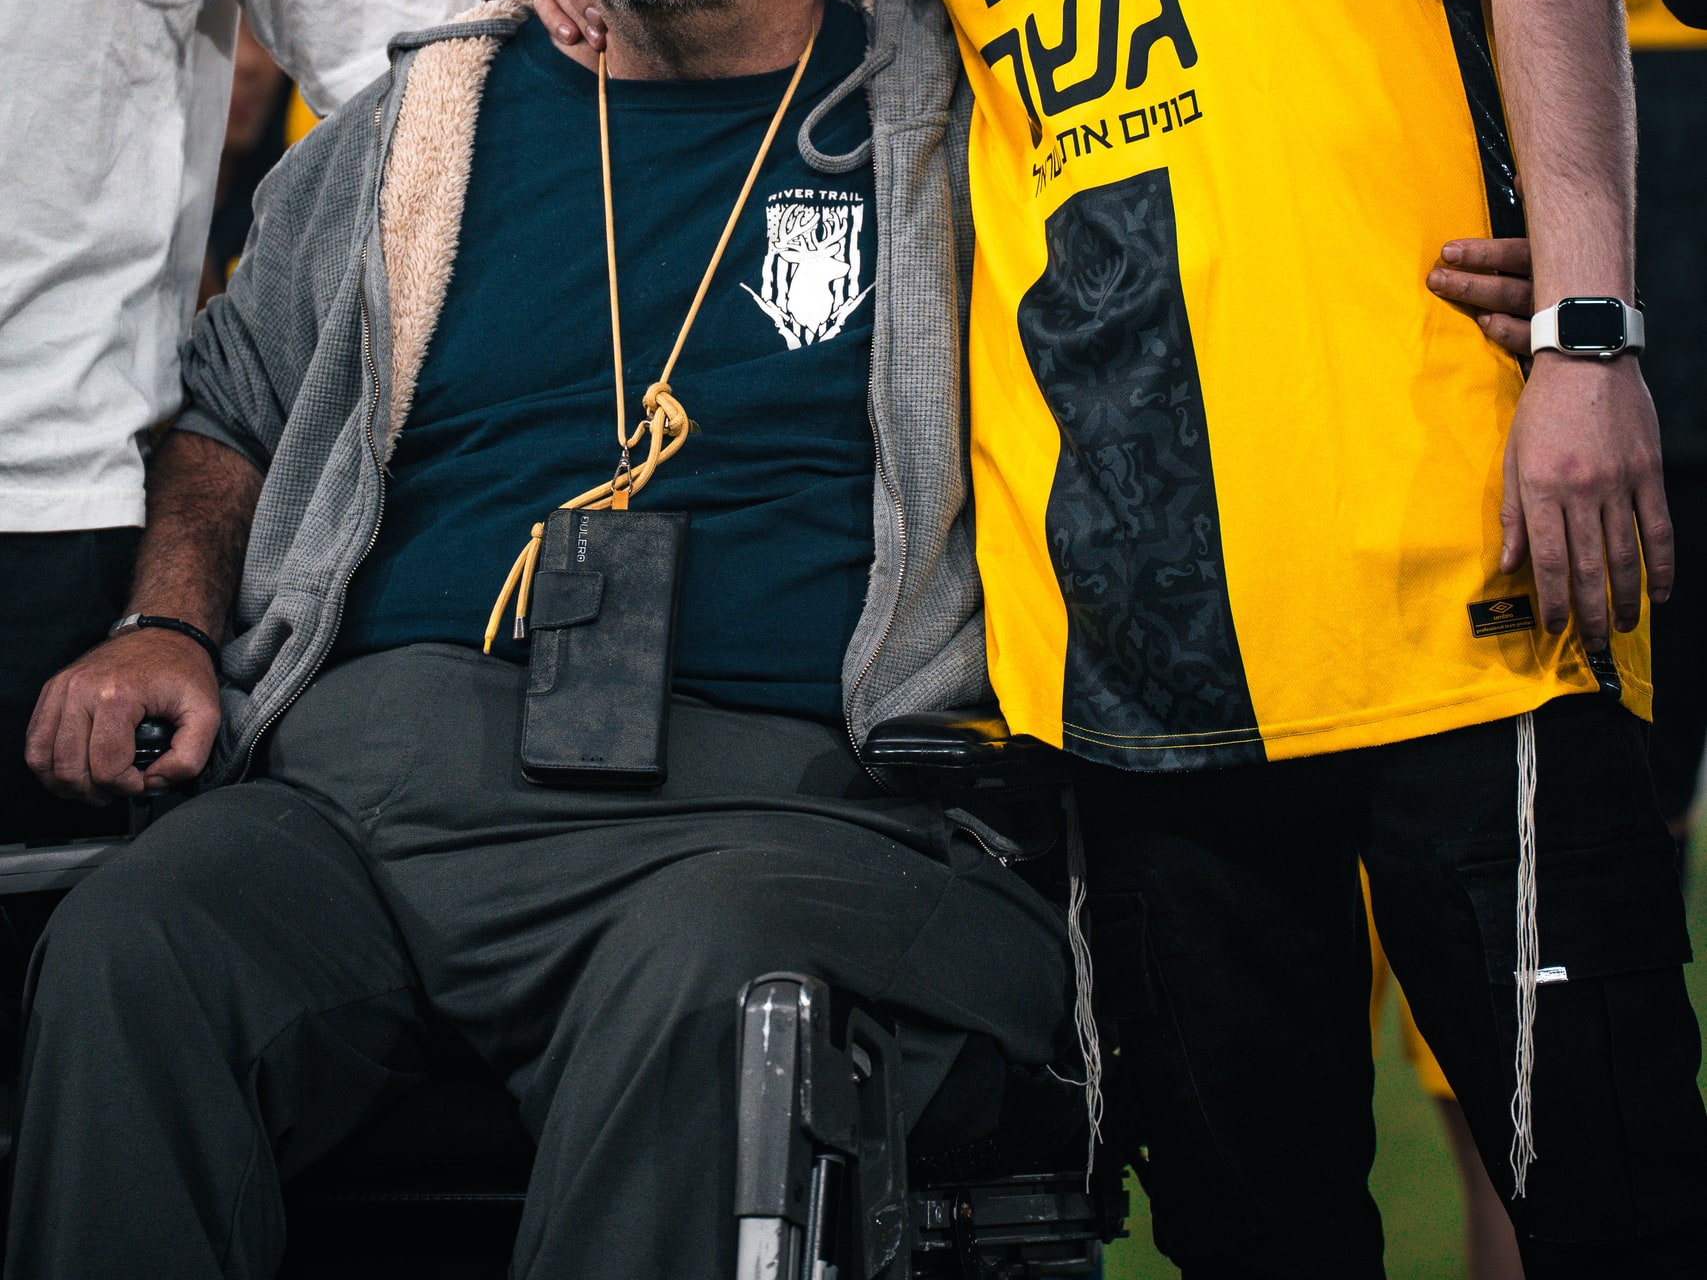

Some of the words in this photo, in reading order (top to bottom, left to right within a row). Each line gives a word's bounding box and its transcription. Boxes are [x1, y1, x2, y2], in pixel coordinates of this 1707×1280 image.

[1118, 88, 1203, 145] בונים
[1056, 119, 1114, 165] את
[768, 189, 813, 202] RIVER
[819, 190, 863, 201] TRAIL
